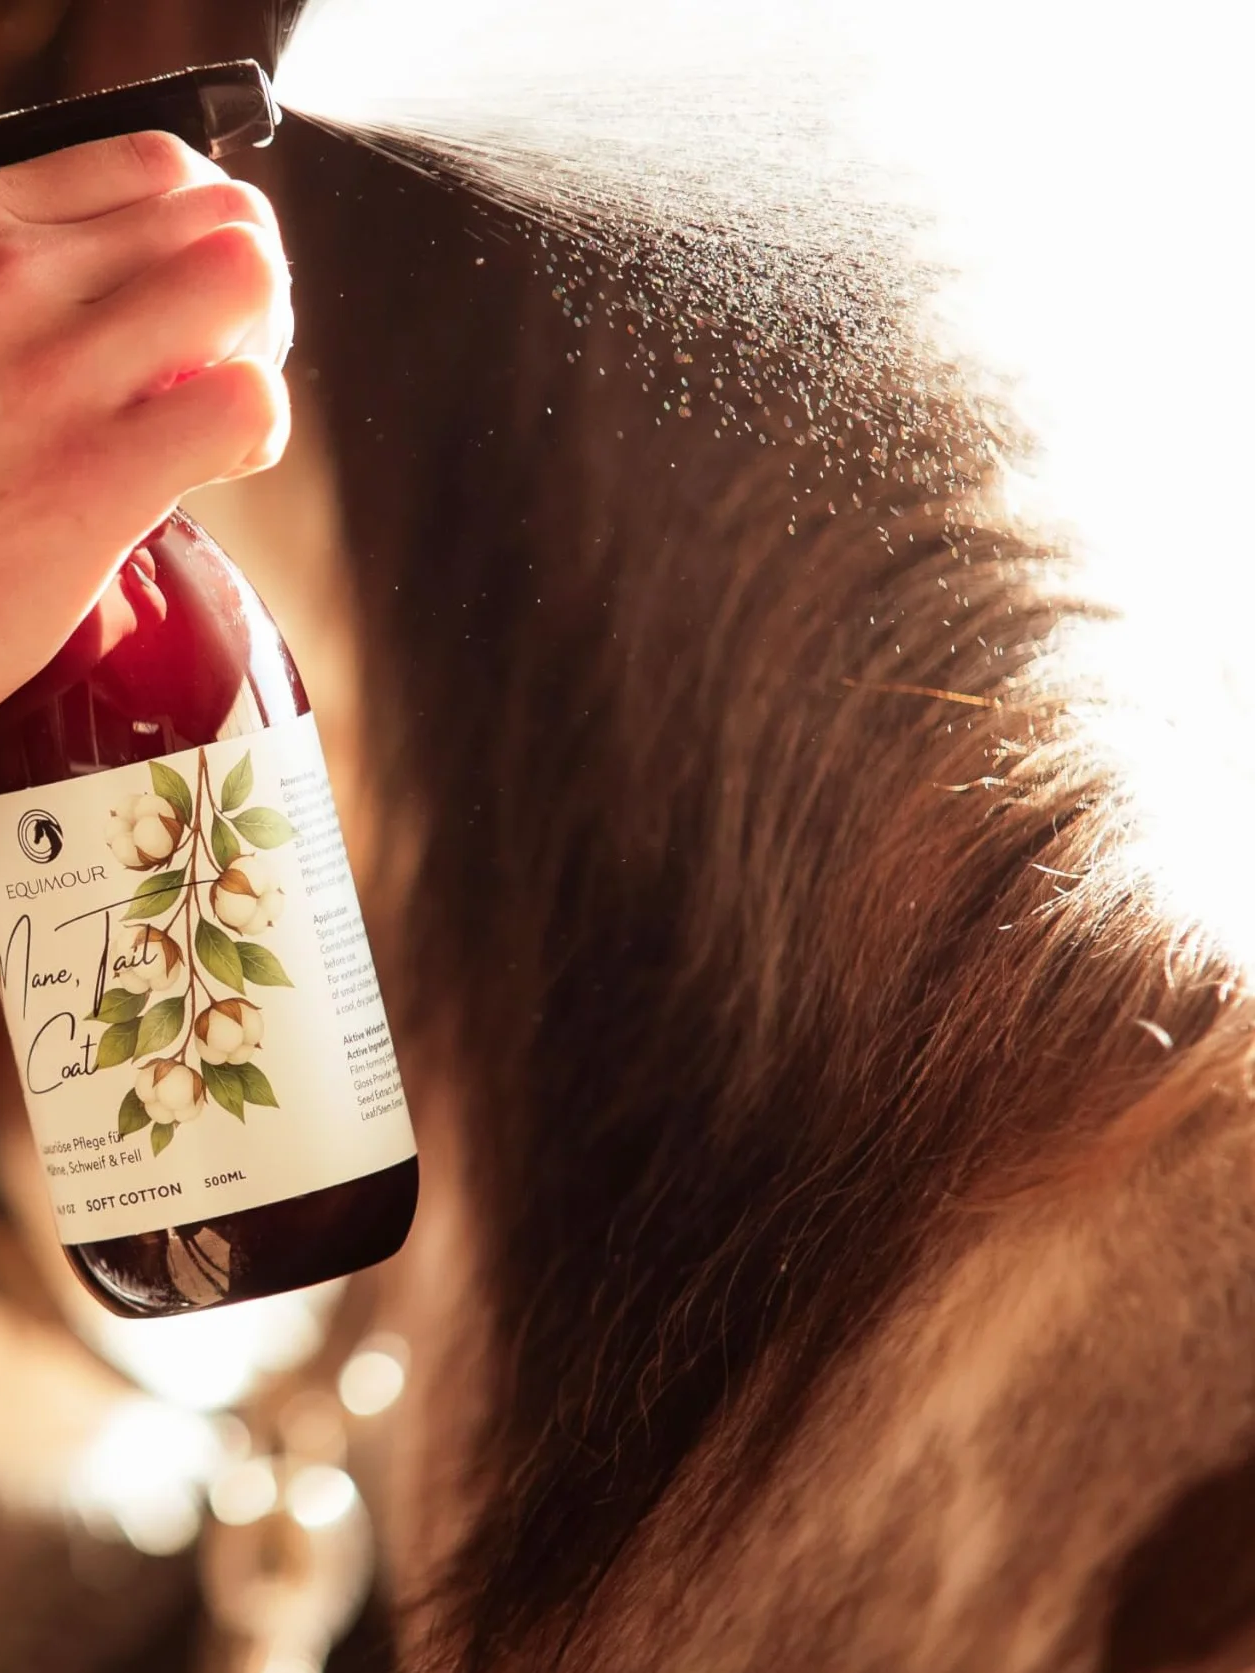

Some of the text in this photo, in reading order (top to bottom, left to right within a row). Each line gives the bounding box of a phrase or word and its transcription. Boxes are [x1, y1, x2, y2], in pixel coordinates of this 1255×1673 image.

[5, 865, 108, 900] EQUIMOUR
[55, 879, 222, 1017] Tail
[343, 1031, 365, 1045] Aktive
[27, 1012, 100, 1094] Coat
[347, 1046, 368, 1060] Active
[354, 1077, 373, 1090] Gloss
[357, 1092, 374, 1106] Seed
[72, 1136, 106, 1151] Pflege
[108, 1130, 125, 1144] für
[68, 1155, 106, 1175] Schweif
[109, 1154, 118, 1167] &
[120, 1148, 142, 1165] Fell
[86, 1195, 116, 1213] SOFT
[118, 1182, 183, 1207] COTTON
[204, 1170, 246, 1189] 500ML
